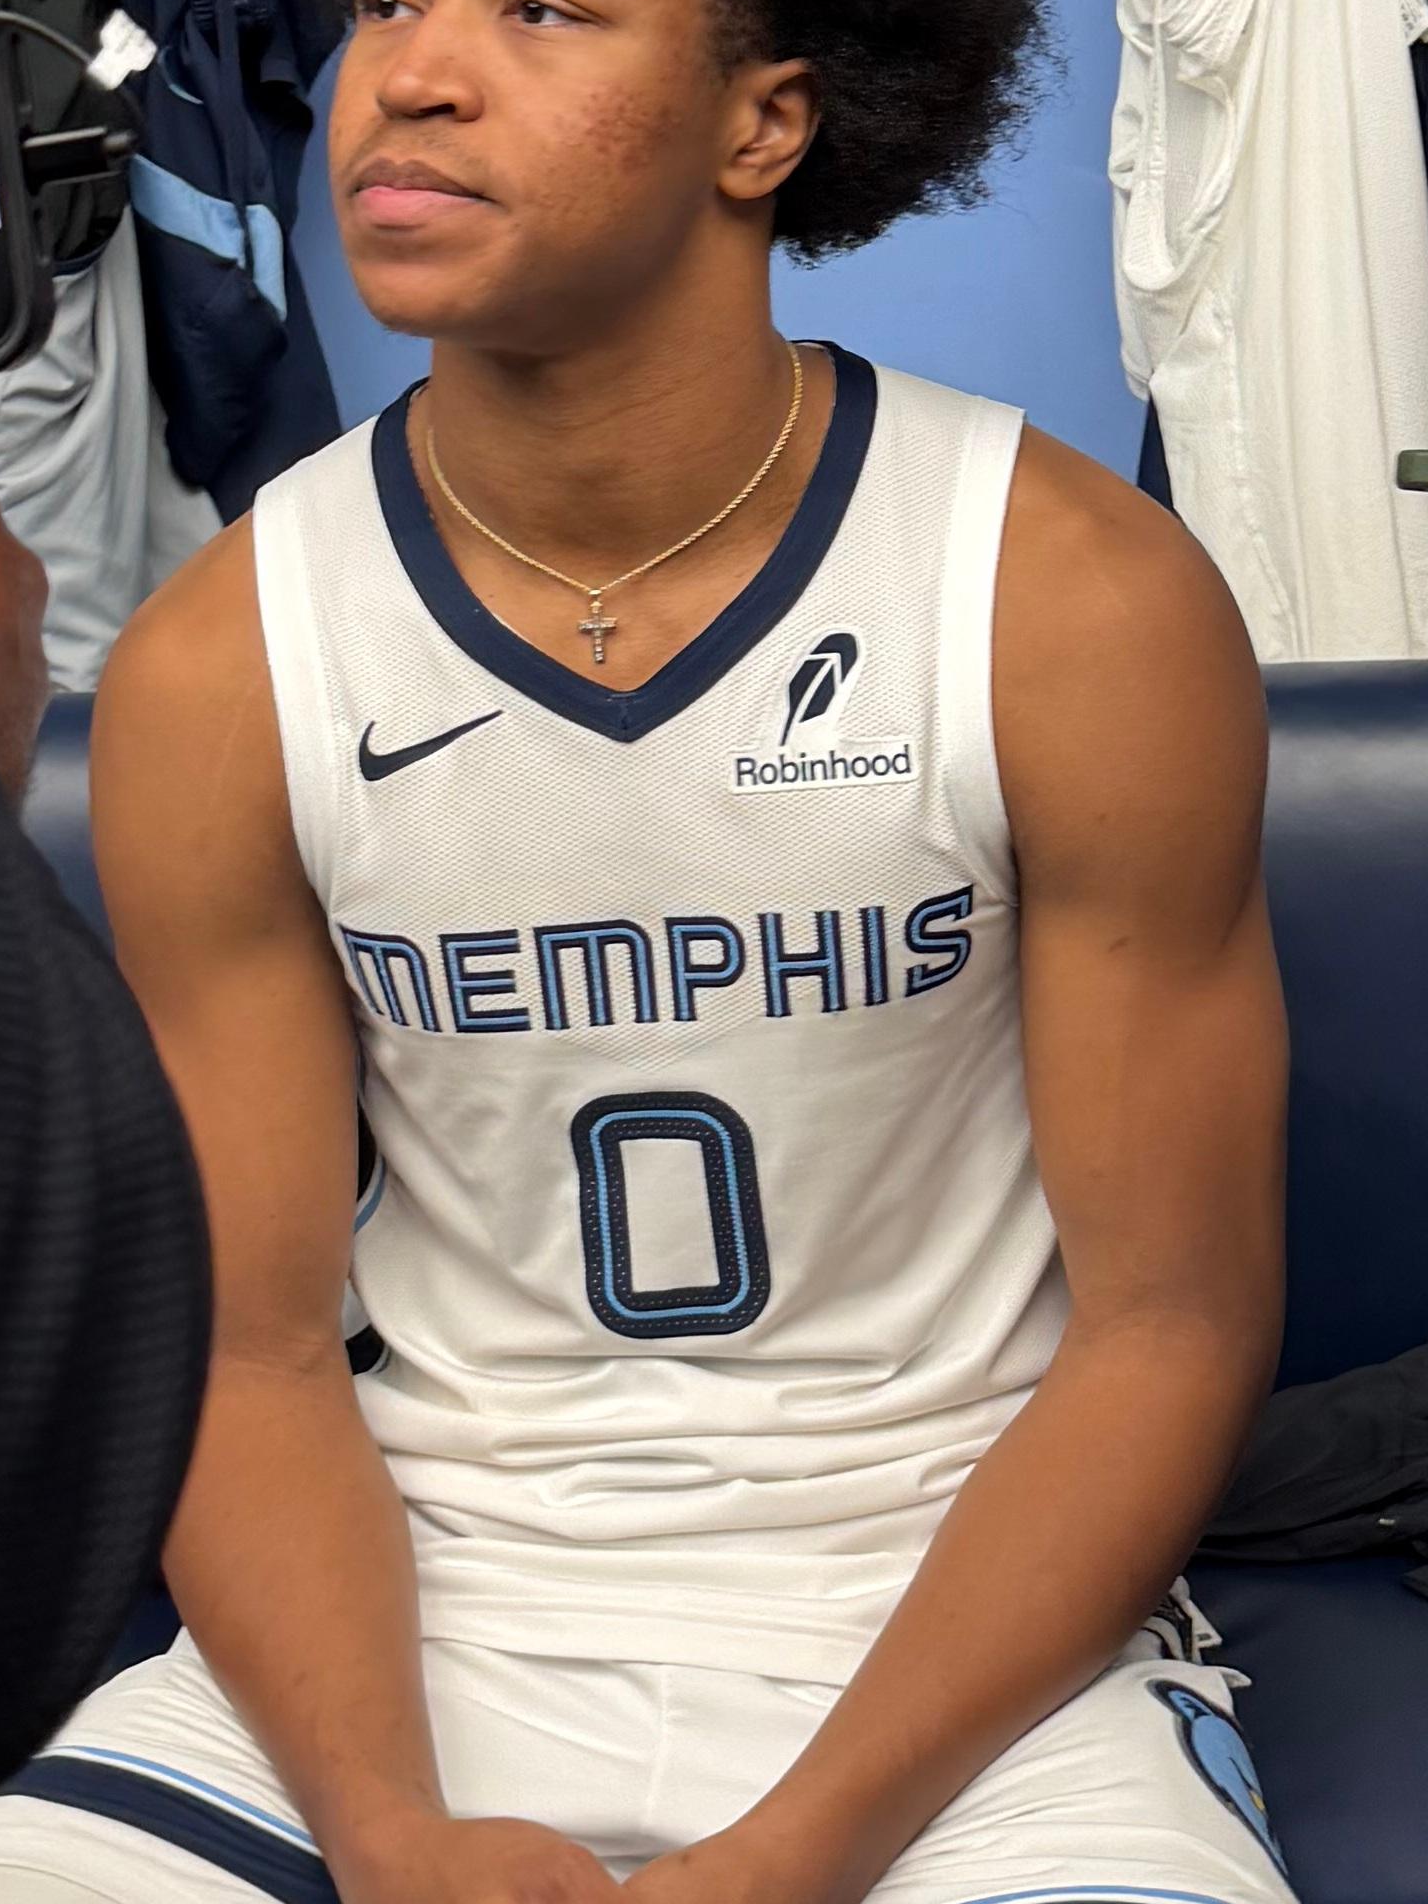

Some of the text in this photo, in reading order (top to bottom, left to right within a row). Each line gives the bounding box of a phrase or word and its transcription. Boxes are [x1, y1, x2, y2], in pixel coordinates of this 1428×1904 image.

[735, 745, 912, 787] Robinhood
[339, 884, 974, 1032] MEMPHIS
[571, 1091, 771, 1339] 0
